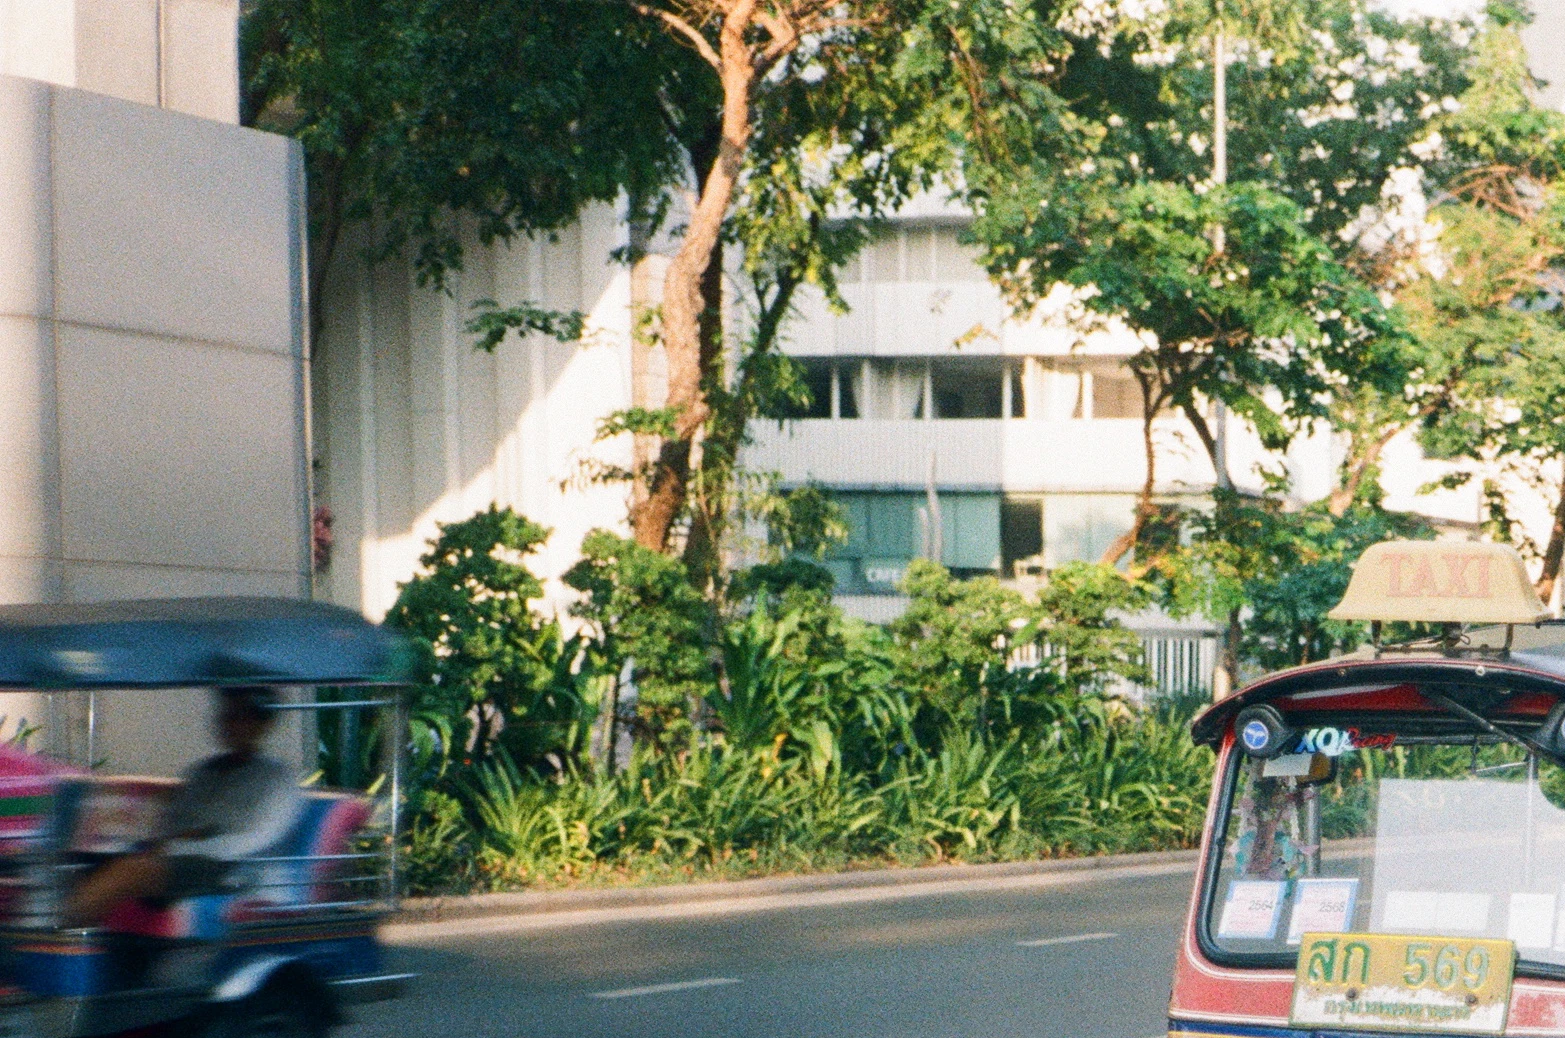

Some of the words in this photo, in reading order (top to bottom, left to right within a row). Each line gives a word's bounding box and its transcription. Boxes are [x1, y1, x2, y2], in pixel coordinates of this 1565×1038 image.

[1380, 552, 1493, 598] TAXI
[1308, 937, 1372, 985] สก
[1402, 942, 1491, 991] 569
